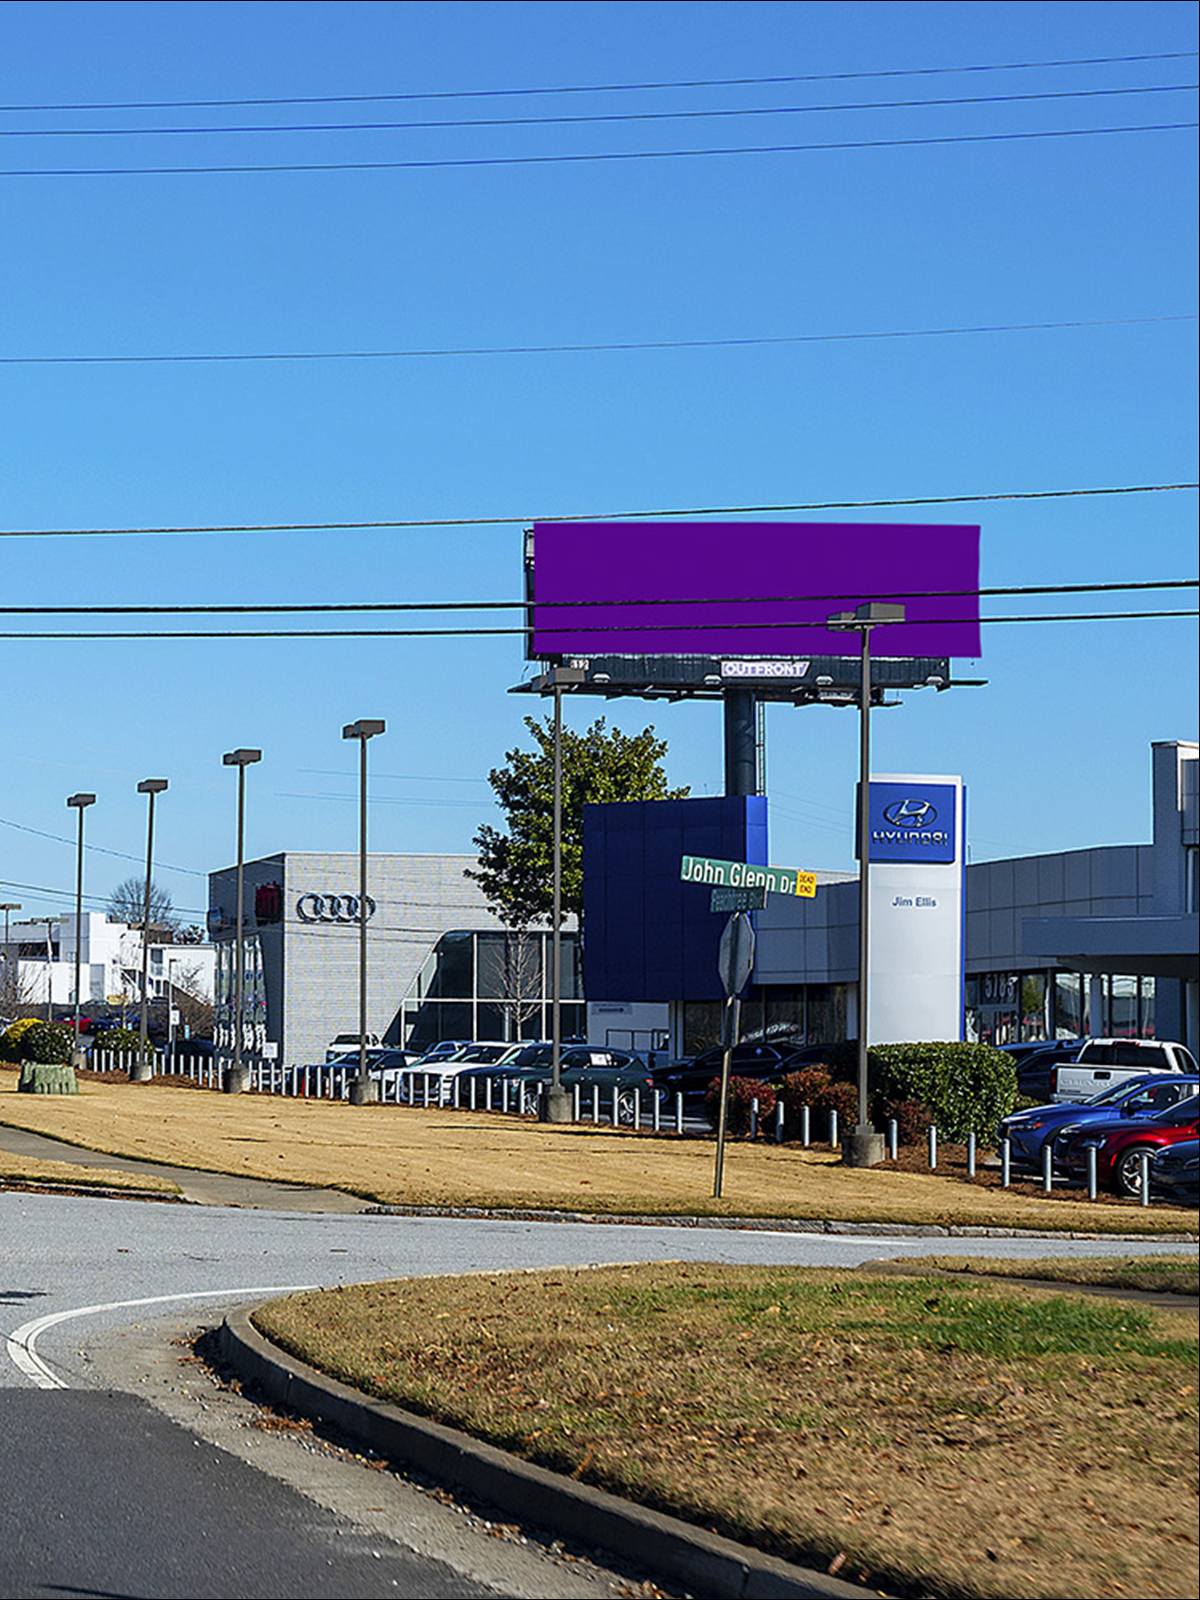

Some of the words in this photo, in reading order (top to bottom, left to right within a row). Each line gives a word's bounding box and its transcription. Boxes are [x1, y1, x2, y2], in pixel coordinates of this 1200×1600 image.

[724, 662, 804, 675] OUTFRONT
[873, 831, 948, 845] HYUNDAI
[683, 858, 724, 885] John
[730, 864, 776, 892] Glenn
[780, 876, 795, 894] Dr
[799, 874, 814, 884] DEAD
[799, 885, 812, 894] END
[892, 897, 912, 907] Jim
[915, 897, 937, 907] Ellis
